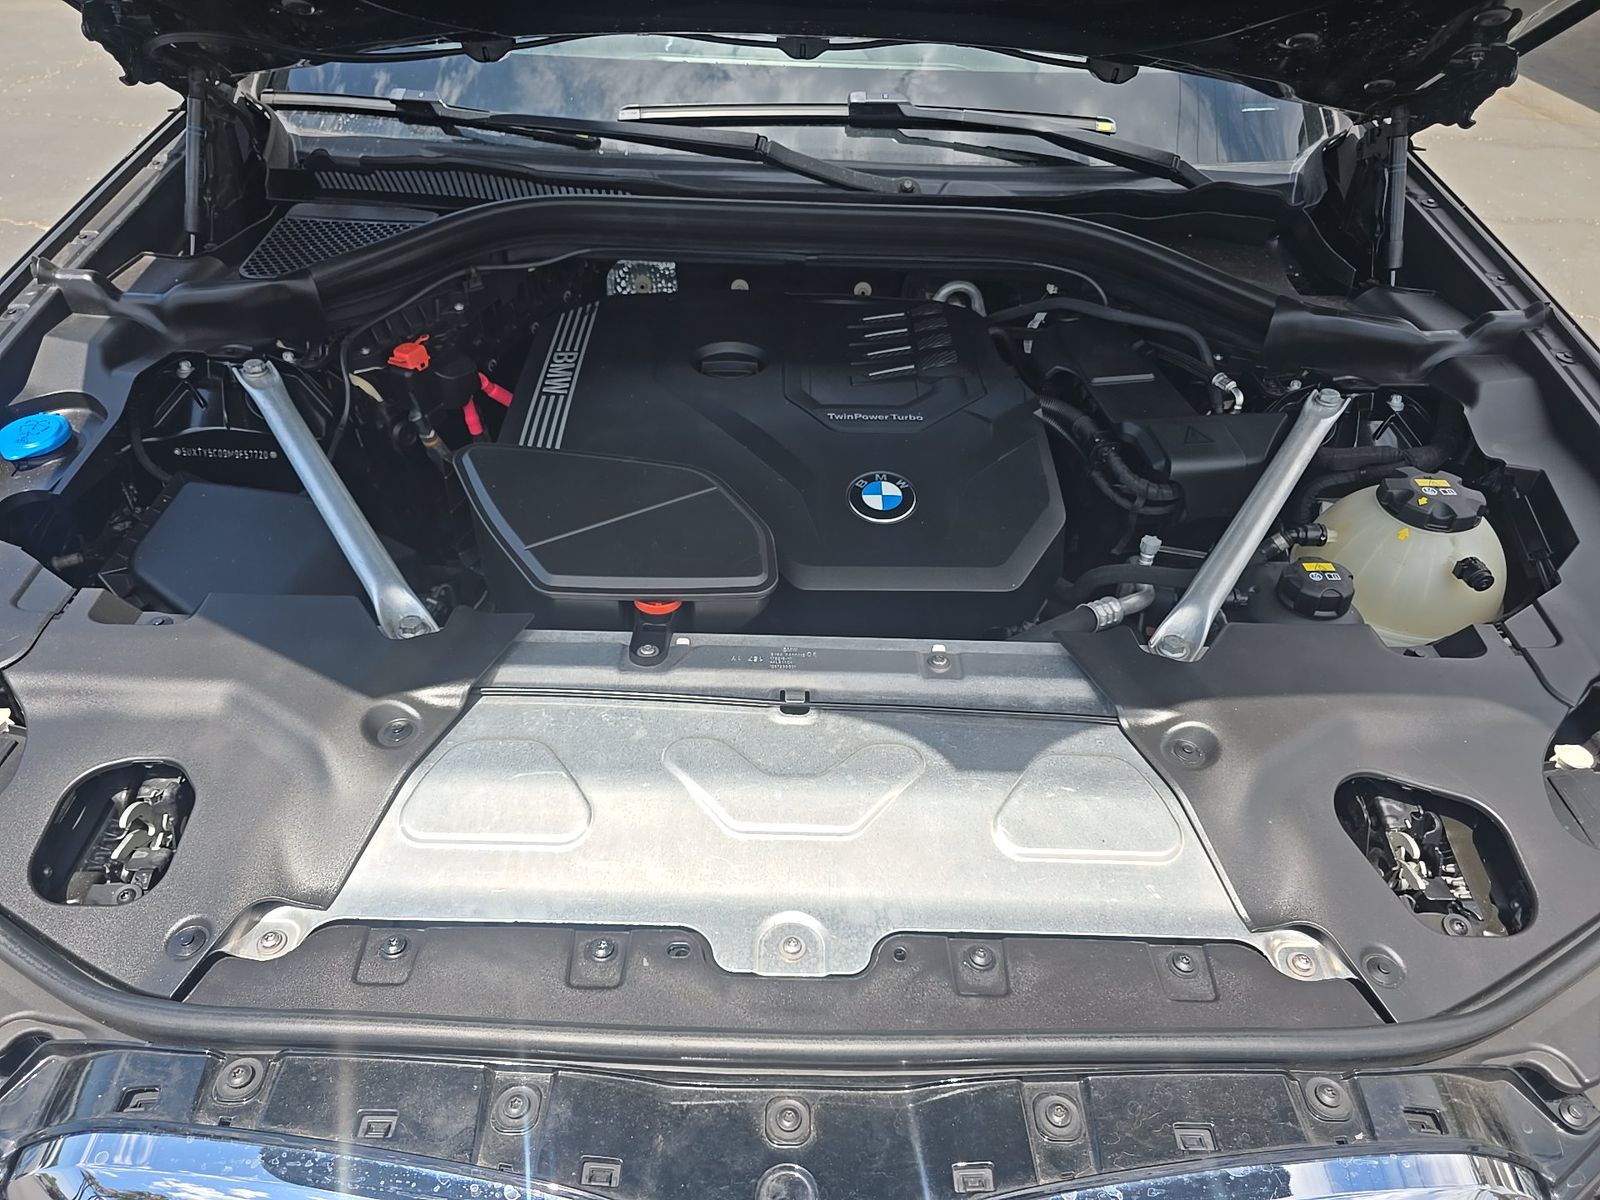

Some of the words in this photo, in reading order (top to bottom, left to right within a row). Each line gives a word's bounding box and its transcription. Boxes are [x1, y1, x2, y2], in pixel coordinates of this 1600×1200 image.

[542, 351, 579, 394] BMW
[890, 413, 924, 421] Turbo
[855, 473, 909, 489] BMW
